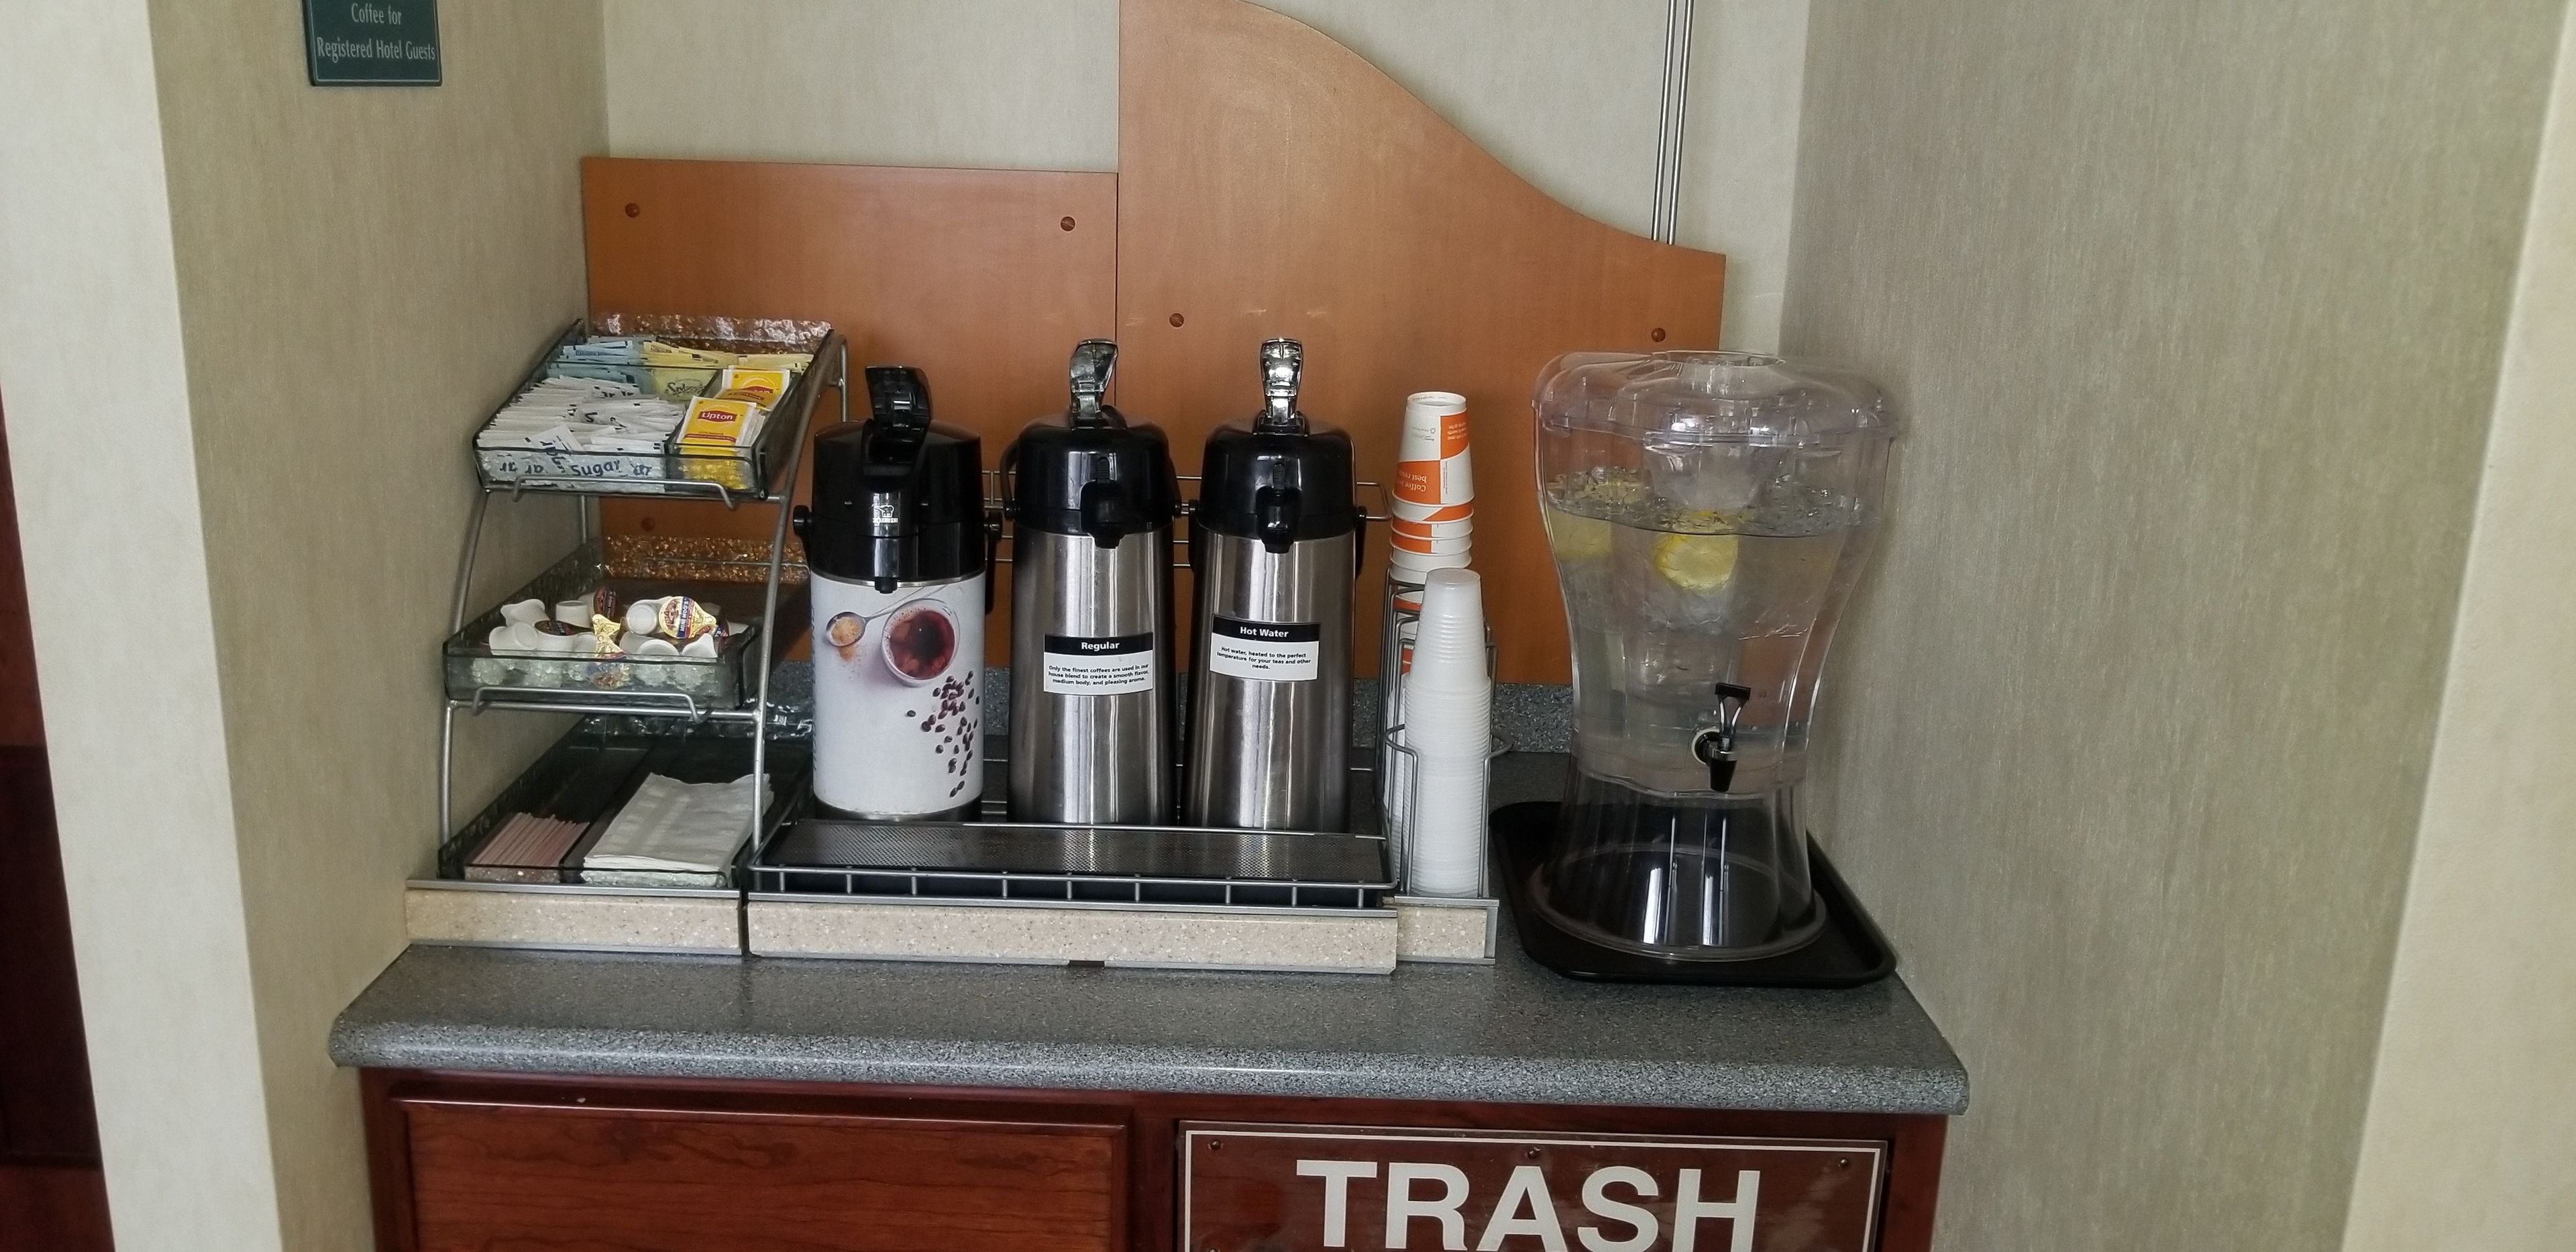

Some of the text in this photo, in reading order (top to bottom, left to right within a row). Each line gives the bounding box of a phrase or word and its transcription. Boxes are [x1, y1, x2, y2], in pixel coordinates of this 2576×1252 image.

[351, 3, 402, 25] Coffee for
[317, 36, 436, 63] Registered Hotel Guests
[701, 411, 734, 420] Lipton
[1240, 626, 1289, 637] Hot Water
[1081, 641, 1120, 651] Regular
[1216, 651, 1247, 661] temperature
[1296, 1159, 1761, 1252] TRASH
